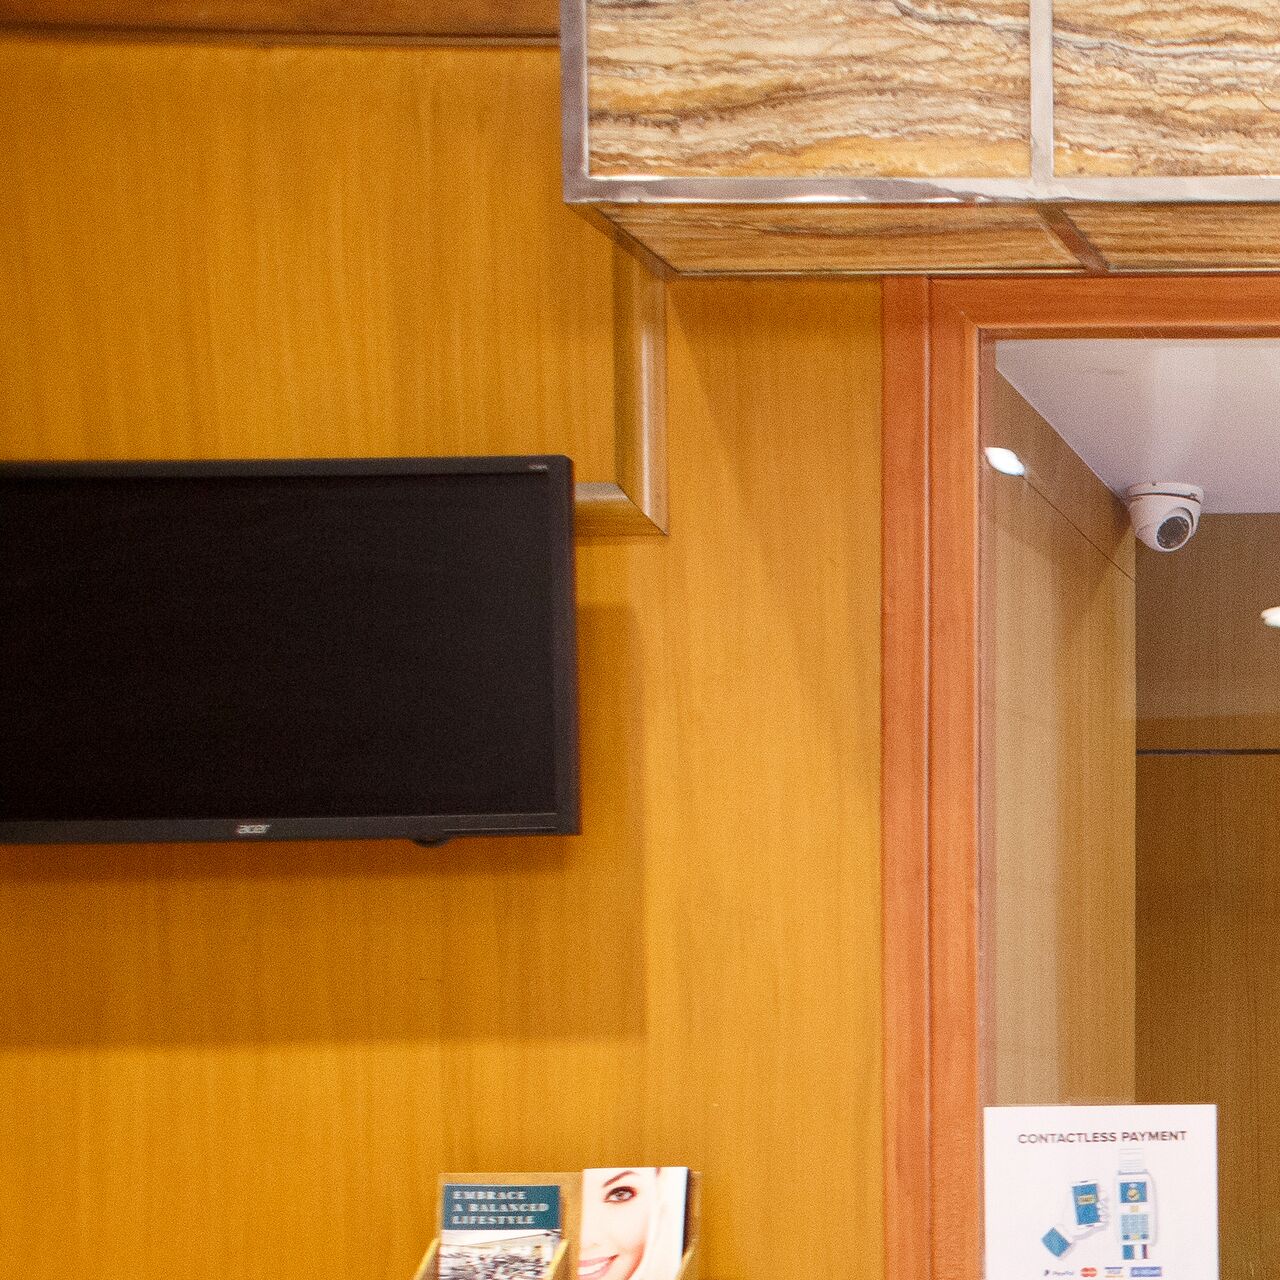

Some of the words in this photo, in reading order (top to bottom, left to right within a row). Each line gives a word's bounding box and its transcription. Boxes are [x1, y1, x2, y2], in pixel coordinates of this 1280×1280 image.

[237, 824, 272, 834] acer
[1018, 1131, 1117, 1144] CONTACTLESS
[1121, 1130, 1187, 1142] PAYMENT
[452, 1191, 528, 1200] EMBRACE
[453, 1203, 463, 1212] A
[467, 1203, 549, 1212] BALANCED
[451, 1216, 535, 1225] LIFESTYLE
